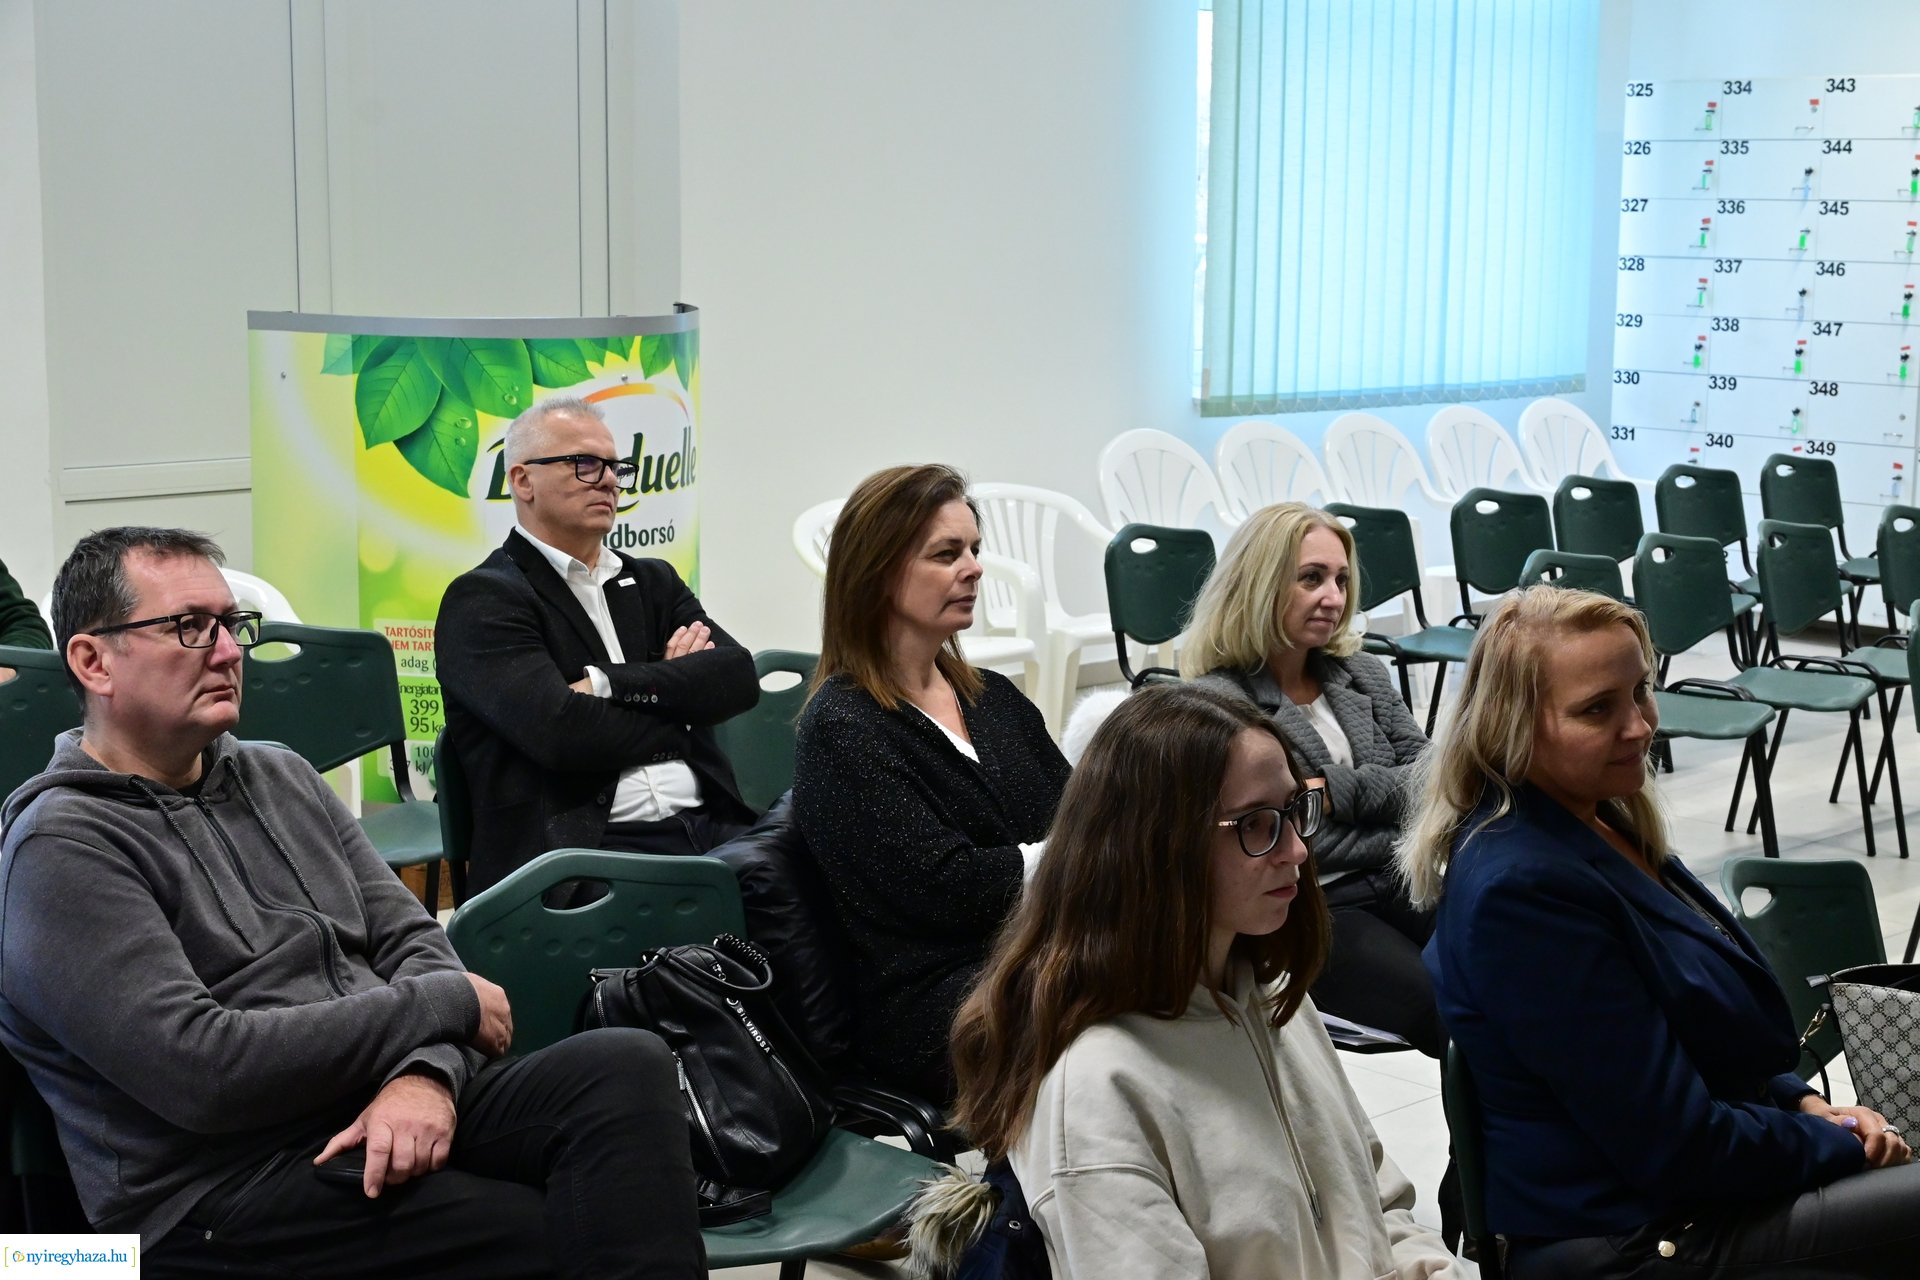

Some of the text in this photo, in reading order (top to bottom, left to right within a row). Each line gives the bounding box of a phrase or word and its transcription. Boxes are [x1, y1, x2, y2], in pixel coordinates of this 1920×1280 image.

[1626, 83, 1654, 97] 325
[1723, 81, 1752, 95] 334
[1826, 78, 1856, 93] 343
[1624, 142, 1651, 155] 326
[1720, 141, 1749, 155] 335
[1822, 140, 1852, 154] 344
[1621, 199, 1648, 212] 327
[1717, 200, 1745, 214] 336
[1819, 201, 1849, 215] 345
[1619, 258, 1645, 271] 328
[1714, 260, 1742, 273] 337
[1816, 262, 1846, 276] 346
[1616, 314, 1643, 327] 329
[1711, 318, 1740, 332] 338
[1812, 322, 1843, 336] 347
[1613, 371, 1640, 385] 330
[1708, 376, 1737, 390] 339
[1809, 381, 1839, 396] 348
[1611, 427, 1635, 441] 331
[1705, 434, 1734, 448] 340
[1806, 440, 1836, 456] 349
[385, 625, 436, 638] TARTÓSÍT
[413, 641, 434, 651] TAR
[400, 656, 429, 672] adag
[410, 699, 439, 716] 399
[410, 716, 430, 733] 95
[736, 1007, 770, 1053] SILVIROSA
